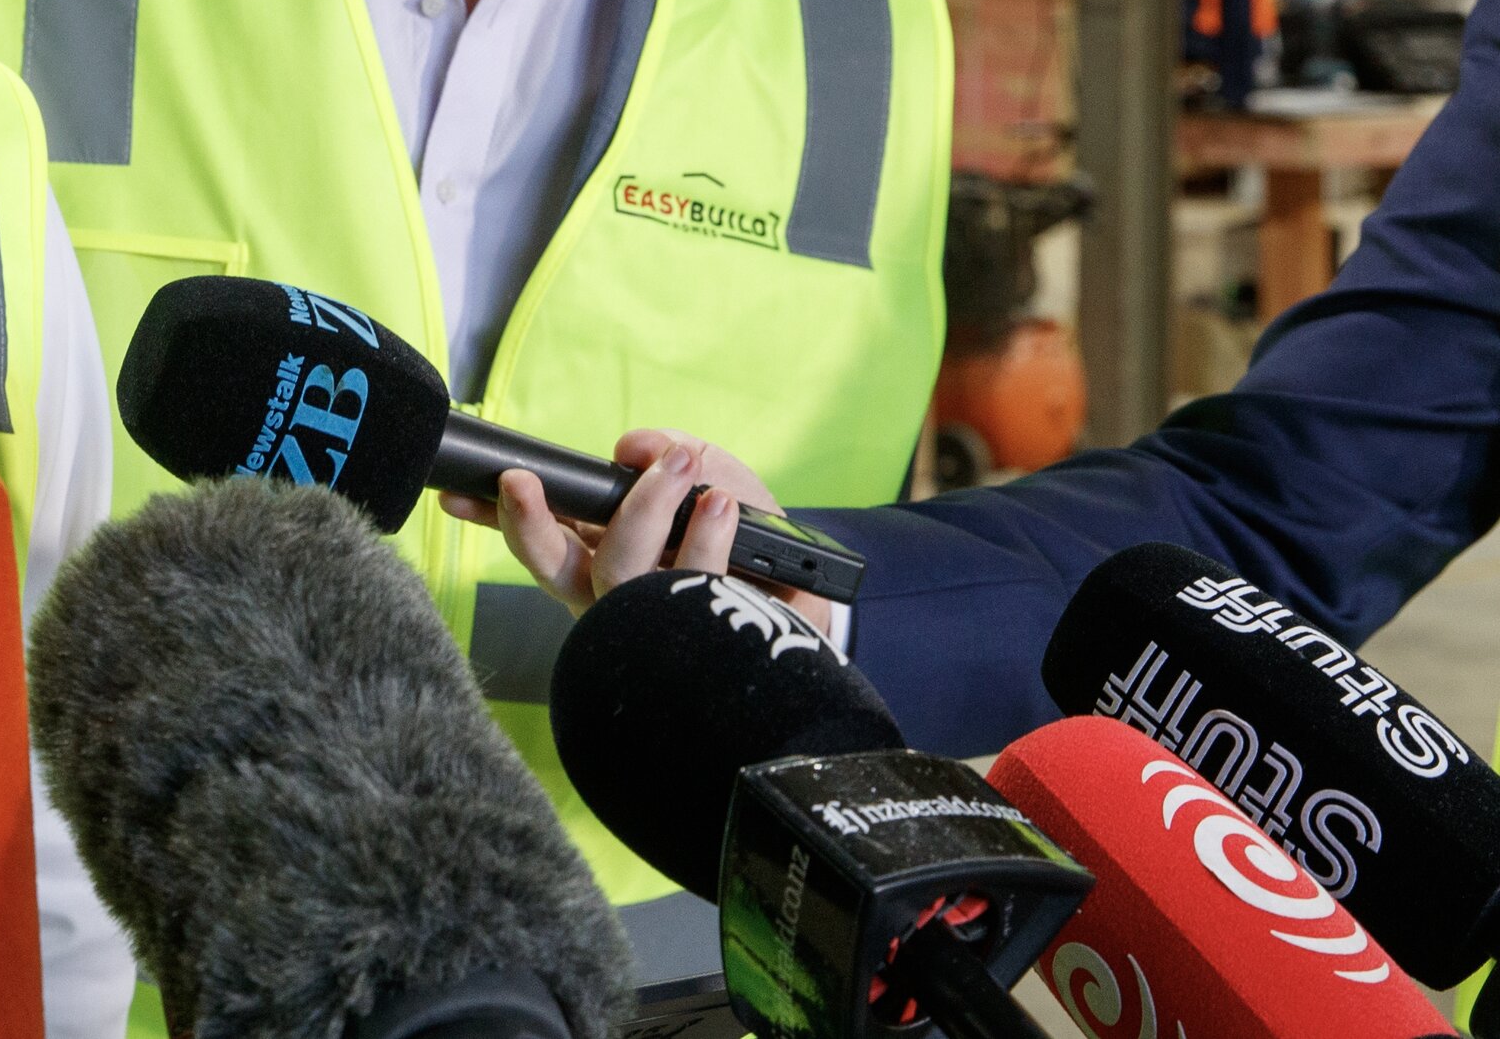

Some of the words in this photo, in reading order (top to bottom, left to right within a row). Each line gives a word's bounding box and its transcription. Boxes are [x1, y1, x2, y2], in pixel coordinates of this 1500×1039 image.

[623, 184, 767, 237] EASYBUILD
[672, 223, 718, 239] HOMES
[264, 363, 369, 491] ZB
[1176, 575, 1469, 779] Stuff
